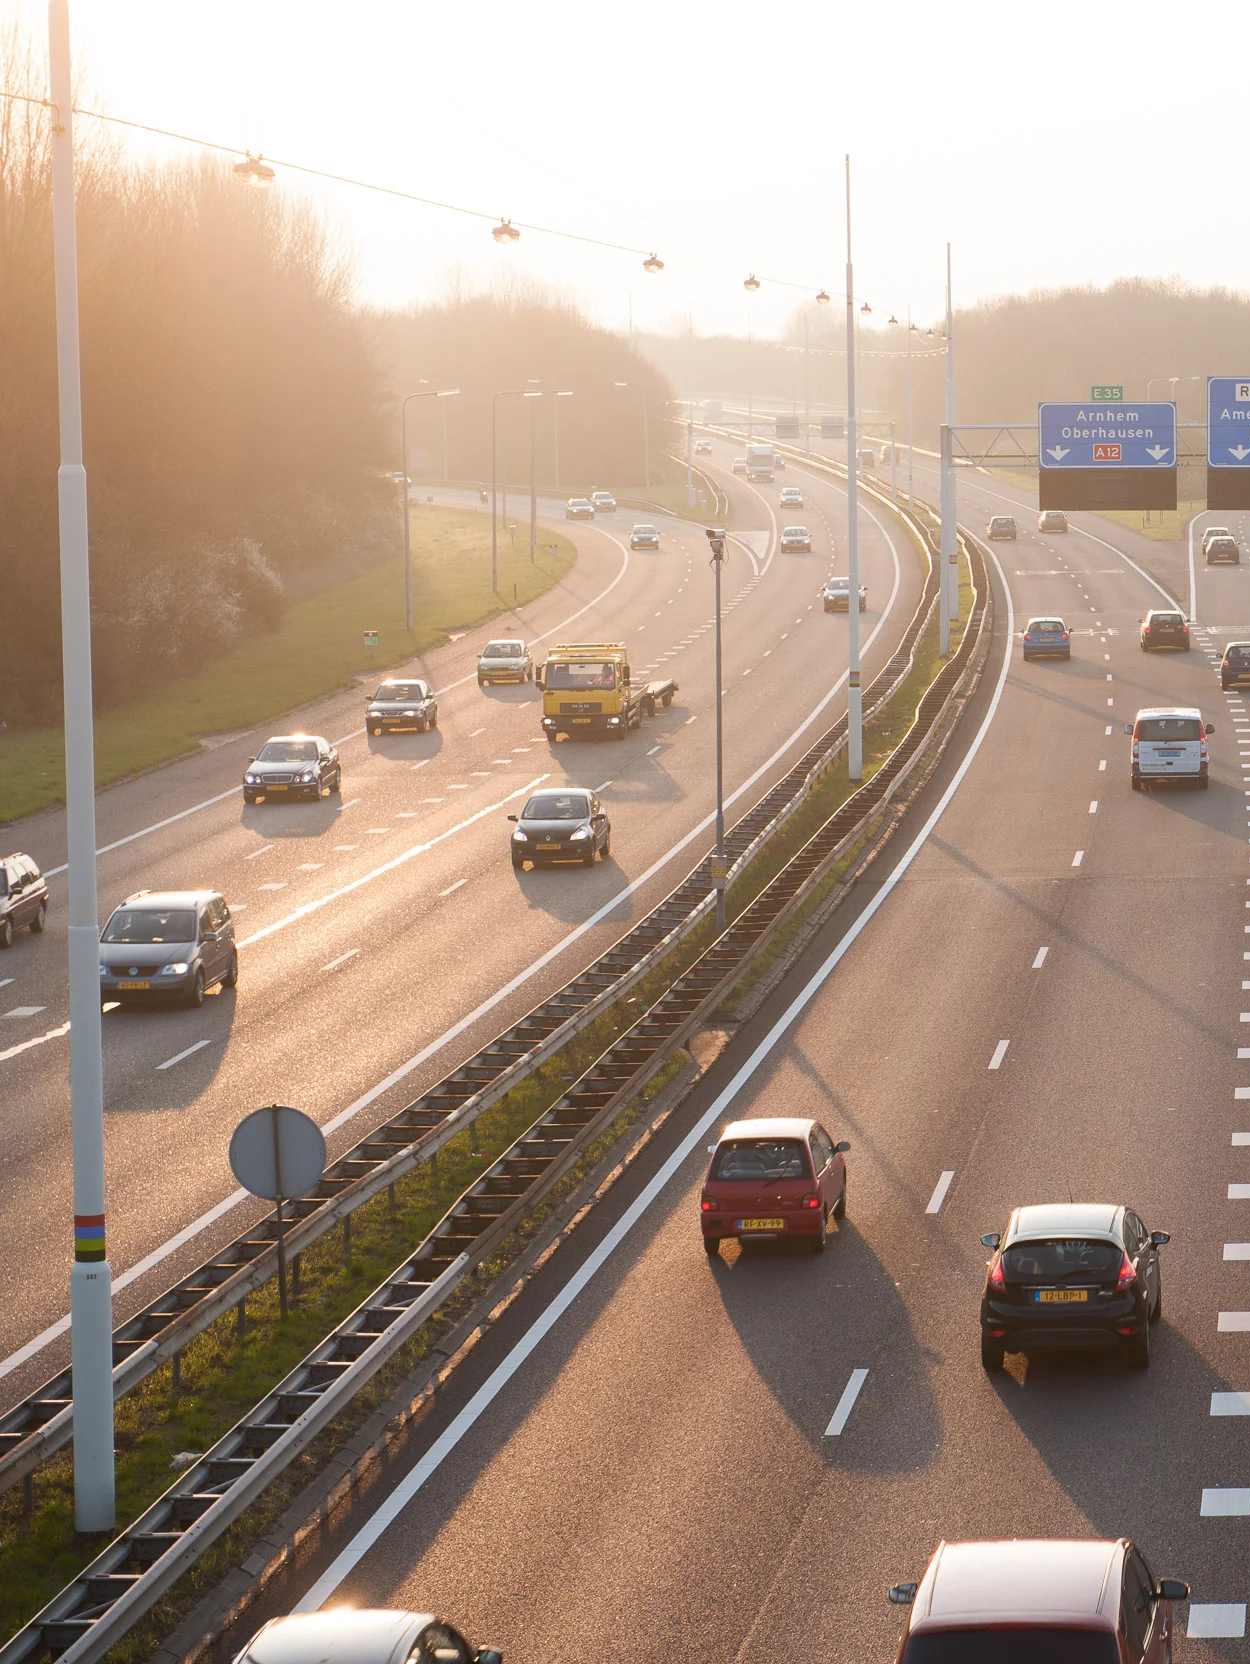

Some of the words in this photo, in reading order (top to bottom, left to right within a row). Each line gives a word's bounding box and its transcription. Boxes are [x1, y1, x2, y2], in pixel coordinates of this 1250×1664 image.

[1076, 410, 1139, 421] Arnhem
[1061, 426, 1153, 438] Oberhausen
[1045, 1291, 1082, 1300] 12-LBP-1
